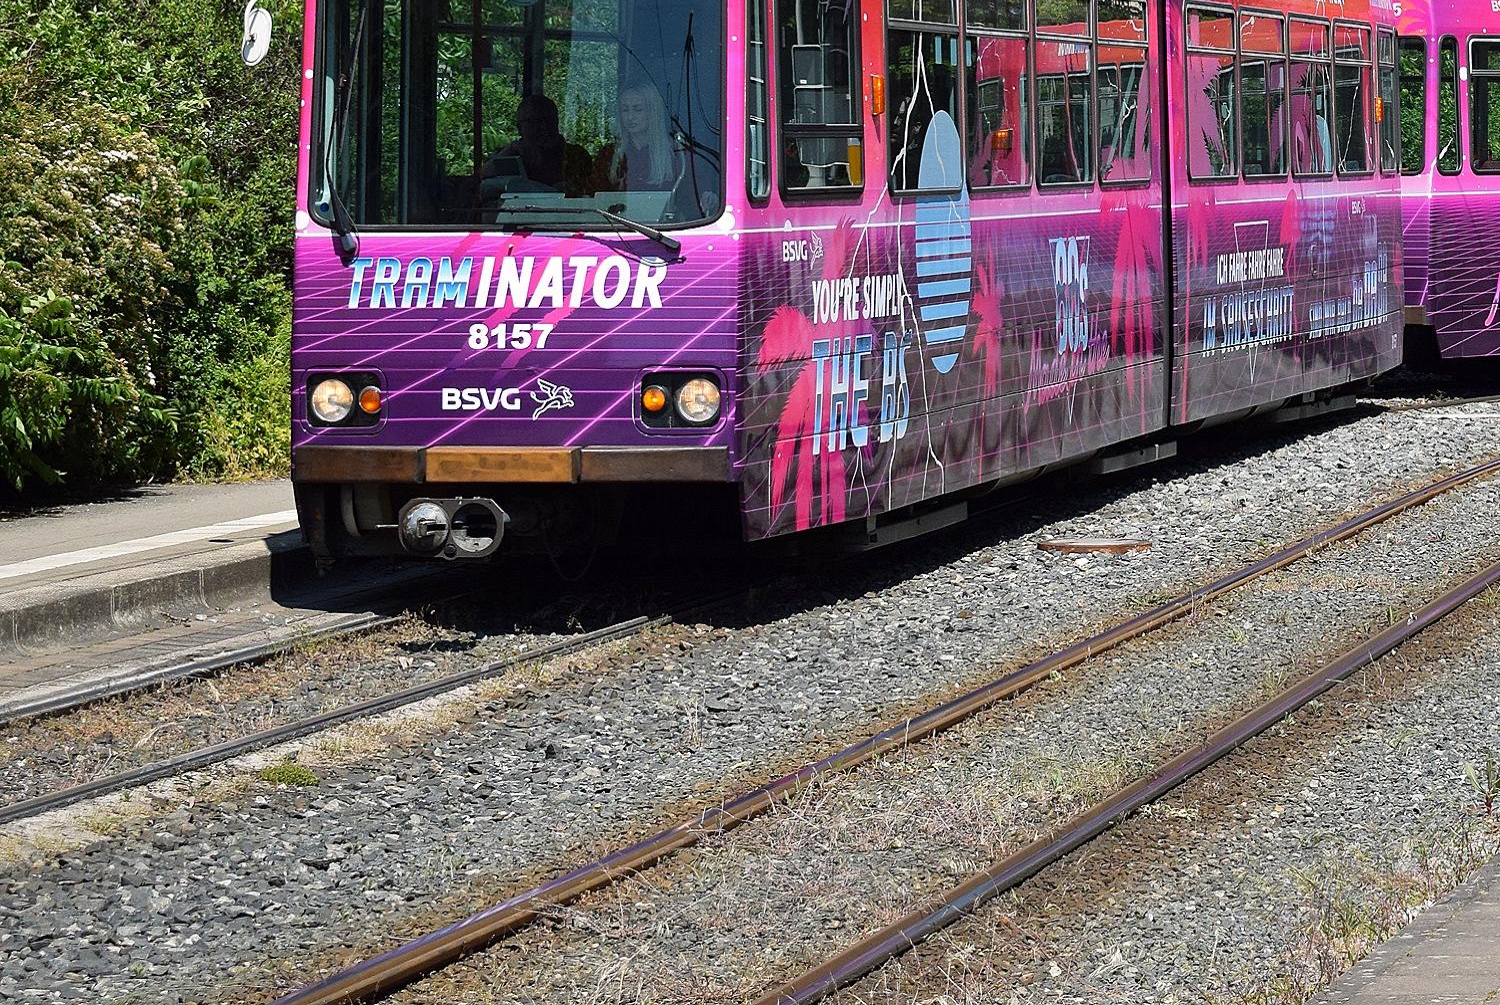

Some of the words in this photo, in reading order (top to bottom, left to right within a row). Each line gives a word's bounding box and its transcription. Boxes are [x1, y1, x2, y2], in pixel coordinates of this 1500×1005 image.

[782, 240, 808, 262] BSVG
[1216, 253, 1228, 285] ICH
[347, 255, 669, 310] TRAMINATOR
[812, 276, 860, 325] YOU'RE
[1055, 236, 1089, 355] 80s
[467, 323, 554, 349] 8157
[441, 387, 521, 410] BSVG
[811, 333, 873, 455] THE
